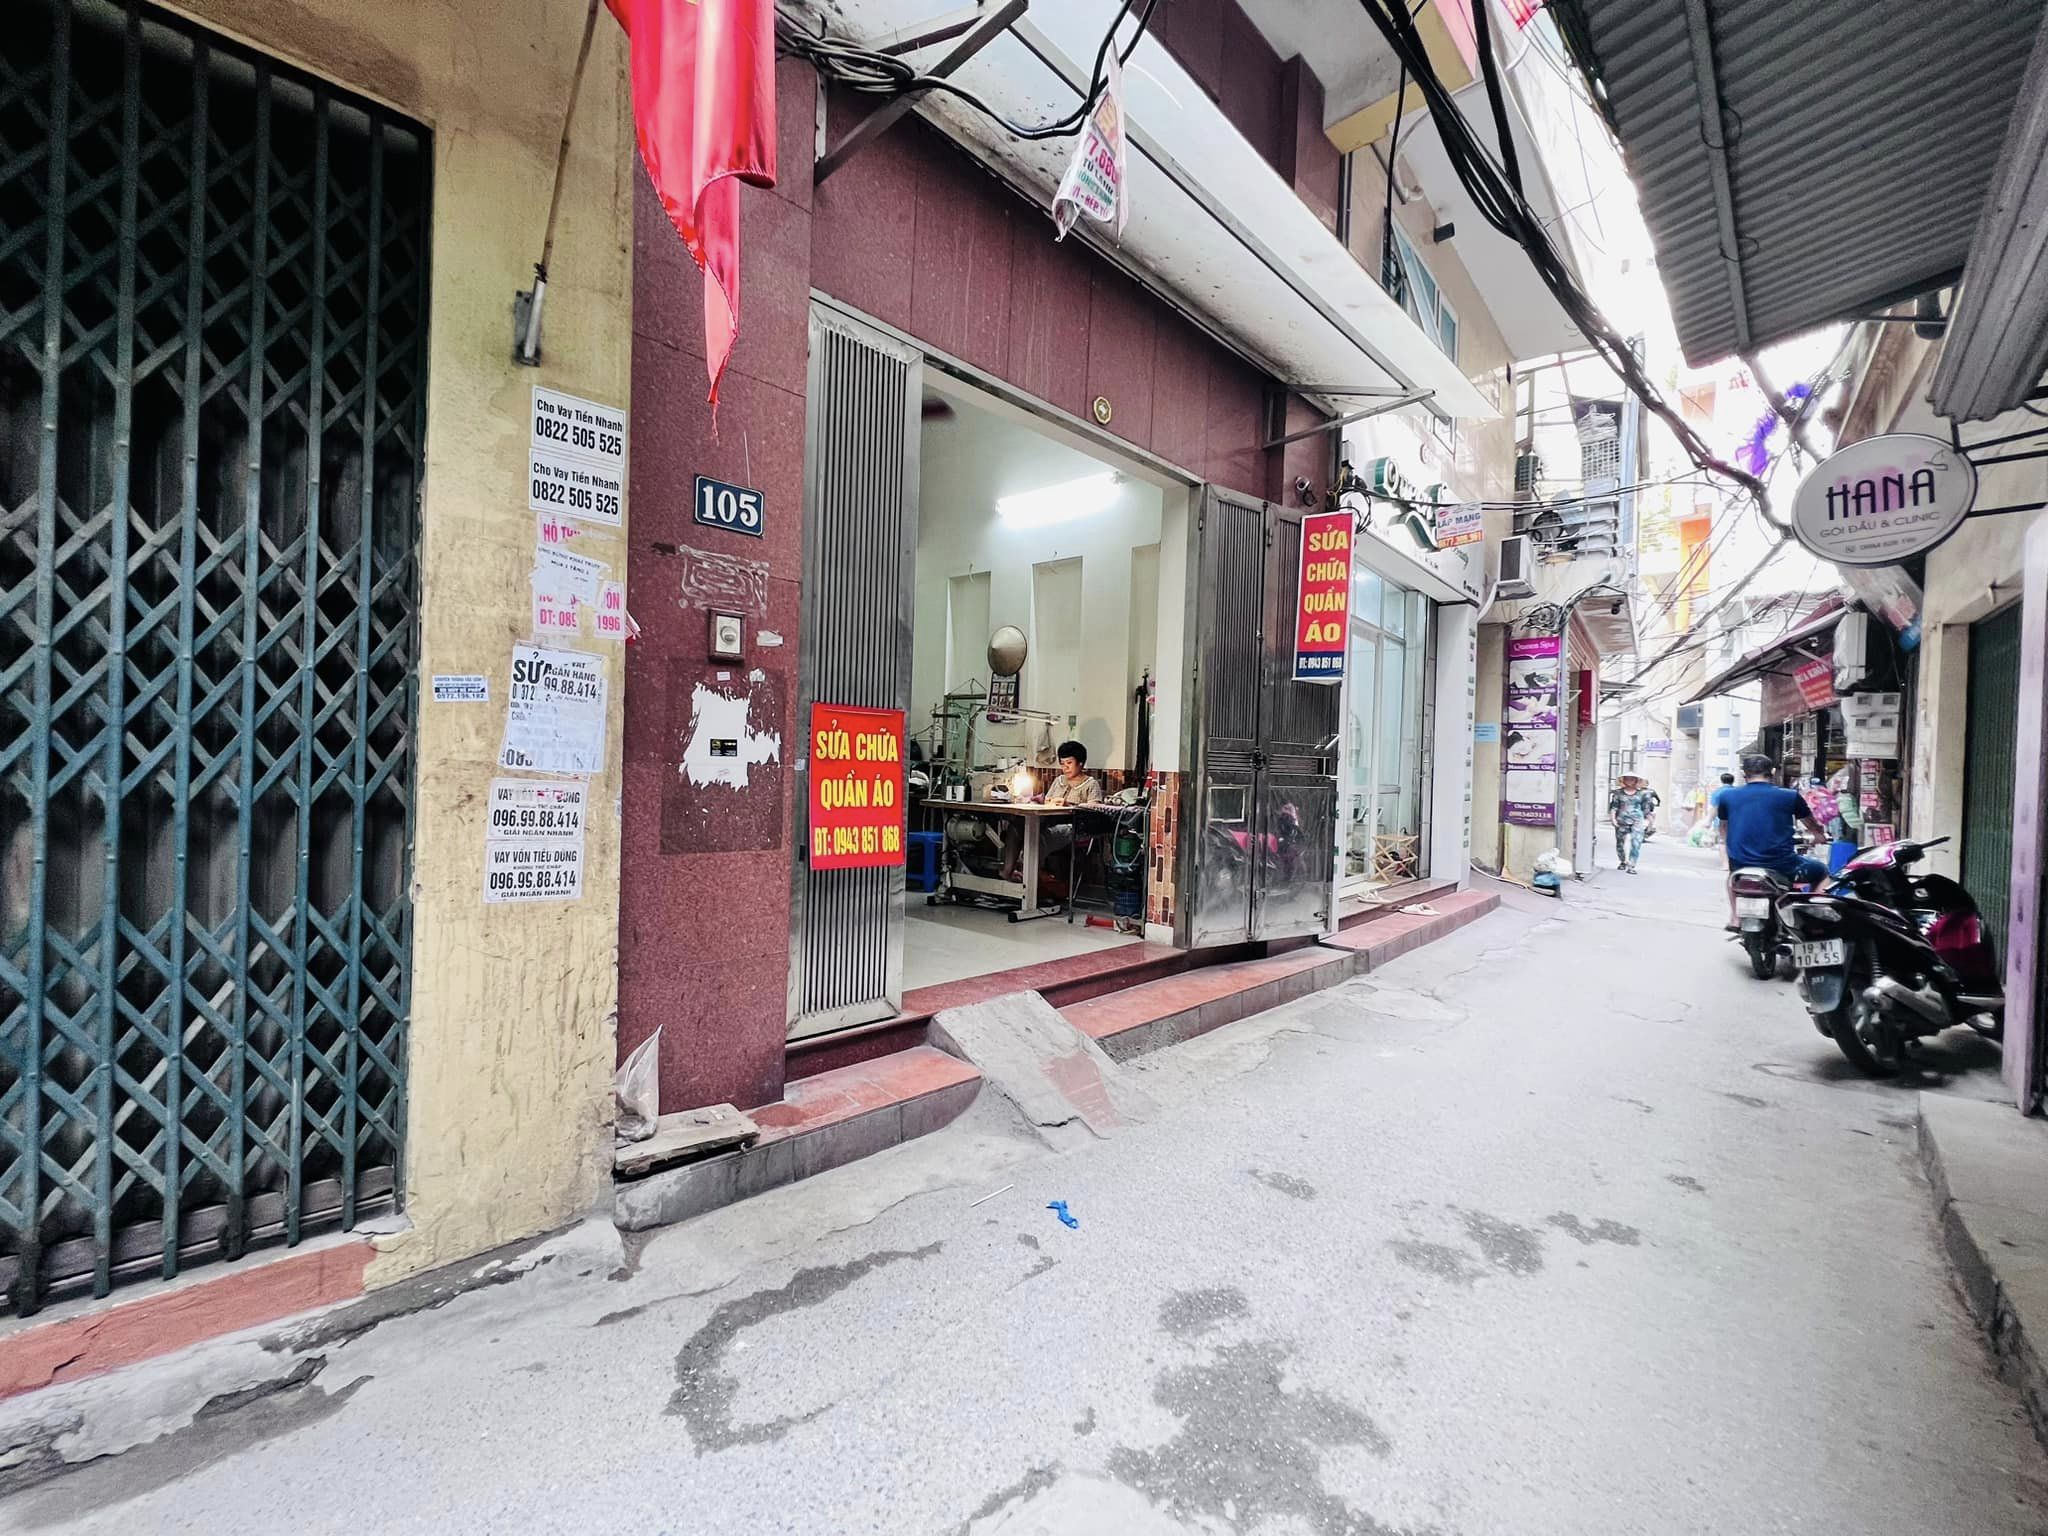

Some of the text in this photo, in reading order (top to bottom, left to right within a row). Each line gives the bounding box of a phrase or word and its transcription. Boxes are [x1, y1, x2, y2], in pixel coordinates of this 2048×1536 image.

[537, 399, 555, 414] Cho
[557, 404, 573, 420] Vay
[595, 415, 623, 432] Nhanh
[536, 416, 622, 456] 0822 505 525
[533, 462, 551, 476] Cho
[553, 467, 569, 481] Vay
[592, 475, 620, 492] Nhanh
[532, 479, 619, 516] 0822 505 525
[702, 485, 759, 528] 105
[1826, 468, 1936, 521] HANA
[1894, 511, 1941, 526] CLINIC
[1308, 524, 1349, 552] SỬA
[1306, 558, 1347, 582] CHỮA
[1303, 586, 1347, 615] QUẦN
[597, 615, 620, 631] 1996
[1304, 620, 1341, 643] ÁO
[816, 720, 899, 761] SỬA CHỮA
[820, 769, 894, 811] QUẦN ÁO
[814, 825, 901, 856] ĐT: 0943 851 868
[494, 850, 510, 863] VAY
